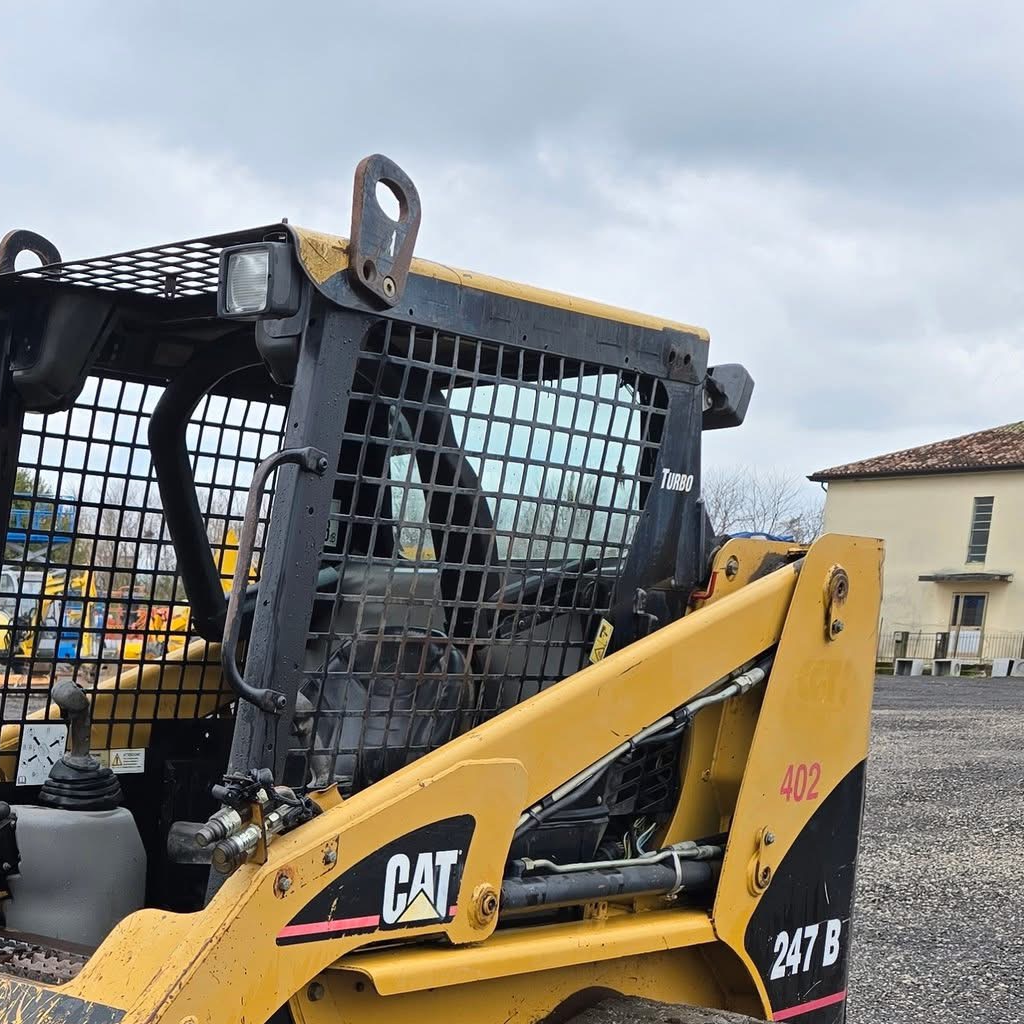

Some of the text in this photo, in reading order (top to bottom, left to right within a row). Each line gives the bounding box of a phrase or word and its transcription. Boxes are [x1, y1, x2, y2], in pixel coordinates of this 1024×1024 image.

[660, 467, 694, 493] TURBO
[779, 762, 822, 802] 402
[382, 849, 459, 925] CAT
[770, 918, 842, 981] 247 B
